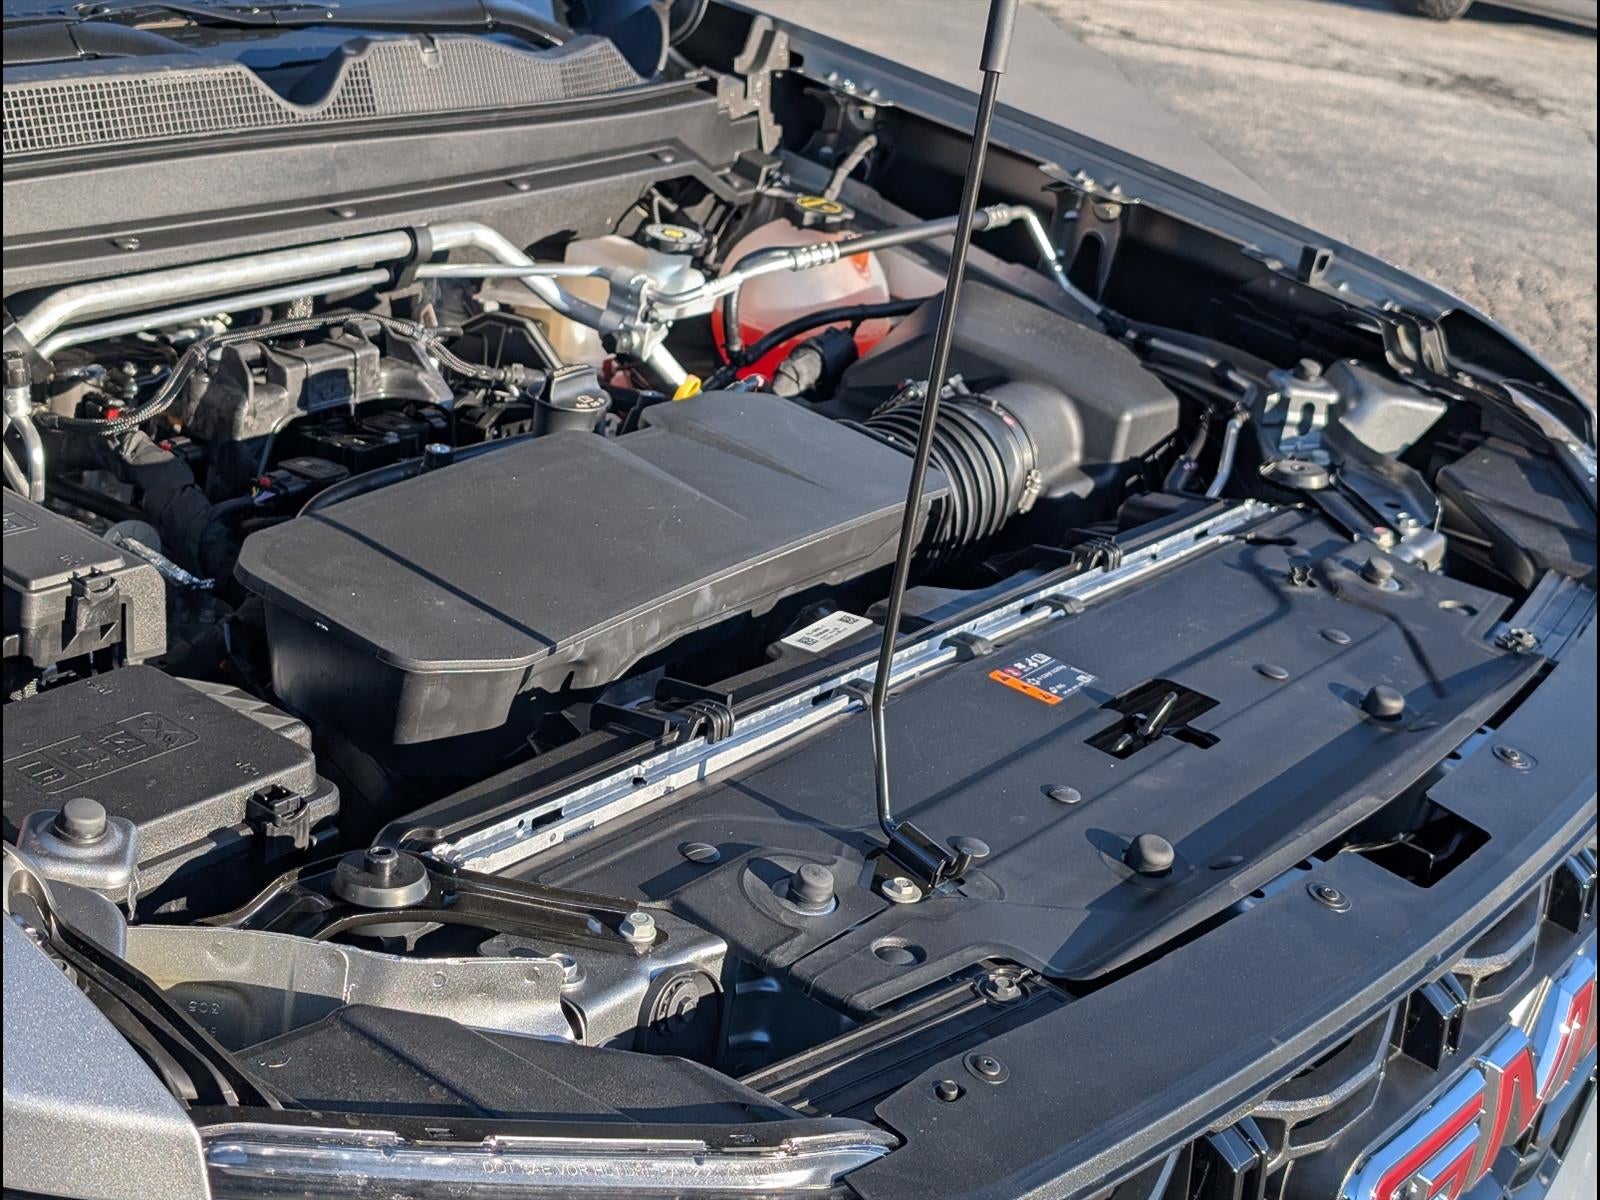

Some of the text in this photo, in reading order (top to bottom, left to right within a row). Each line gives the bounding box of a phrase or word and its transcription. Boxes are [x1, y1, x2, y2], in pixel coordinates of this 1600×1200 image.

[482, 1161, 514, 1174] DOT
[520, 1162, 553, 1176] SAE
[555, 1162, 591, 1177] VOR
